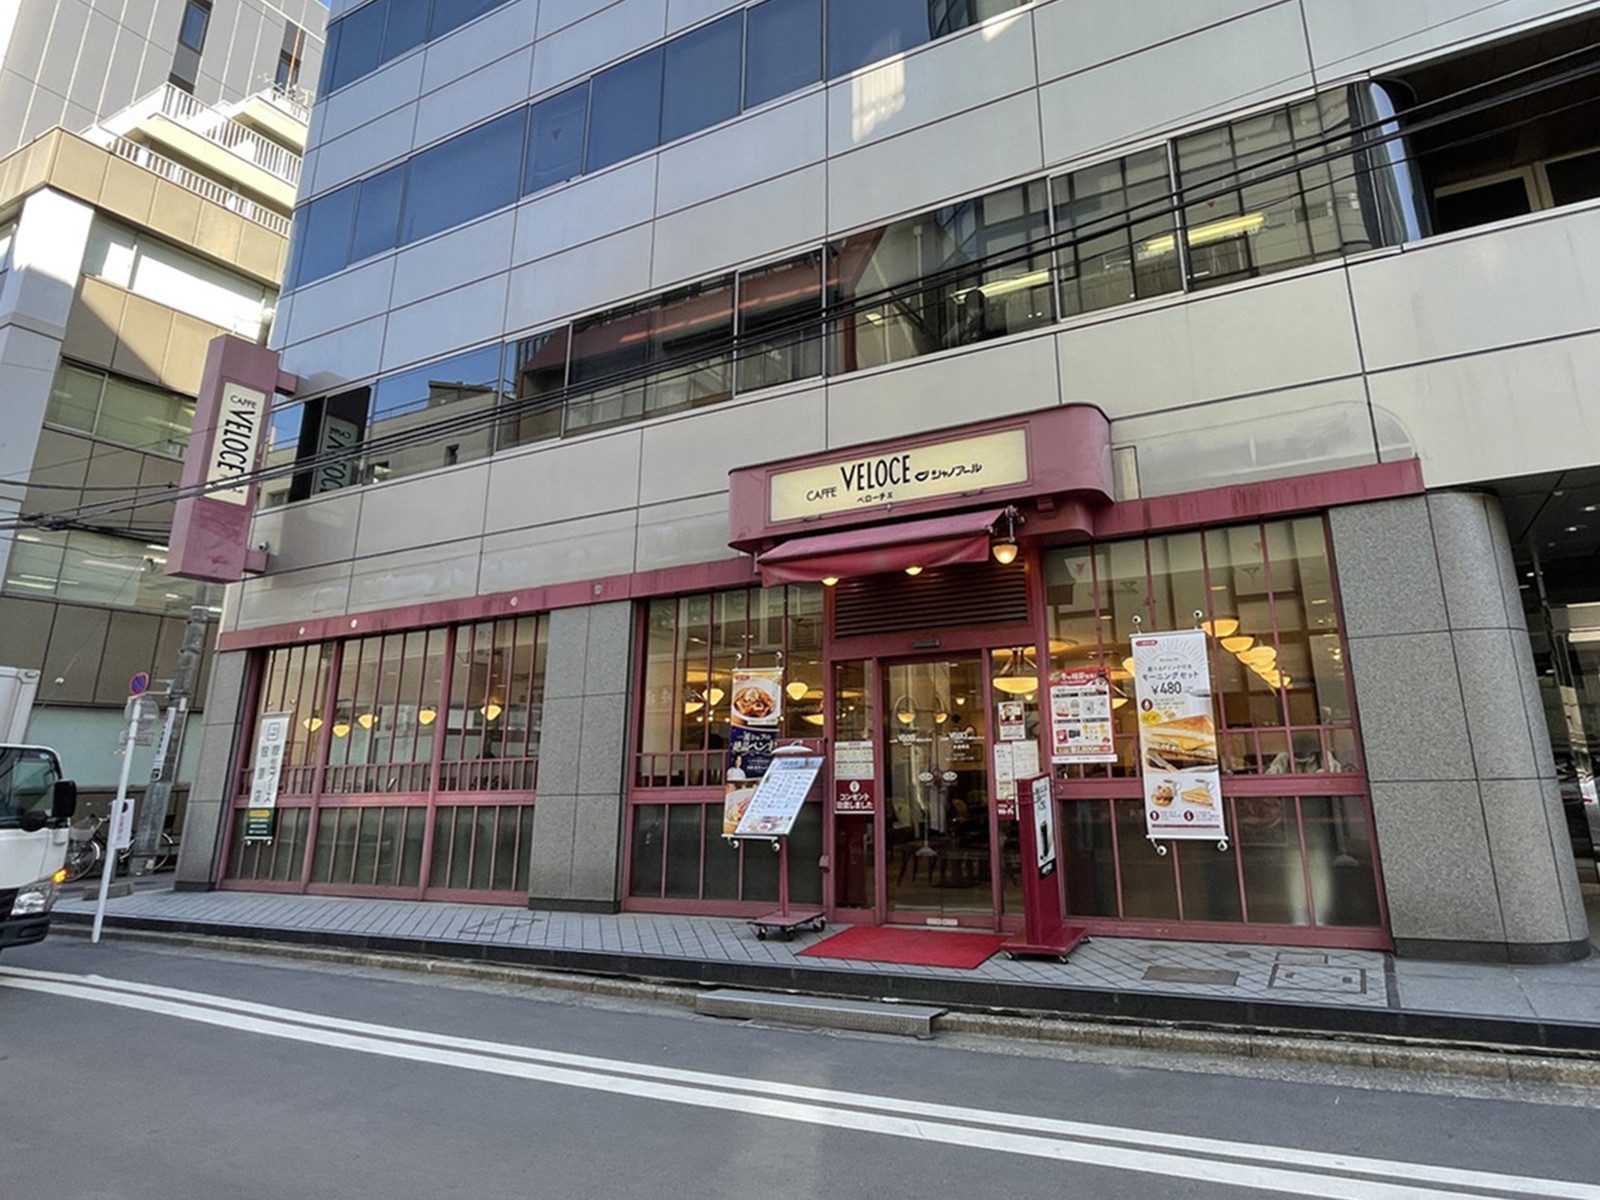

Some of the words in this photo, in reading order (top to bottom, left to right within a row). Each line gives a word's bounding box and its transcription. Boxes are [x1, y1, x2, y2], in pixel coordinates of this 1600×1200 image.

[230, 394, 257, 409] CAFFE
[217, 410, 255, 474] VELOCE
[806, 487, 838, 502] CAFFE
[840, 454, 911, 492] VELOCE
[930, 463, 983, 480] シャノアール
[1151, 681, 1182, 695] ¥480
